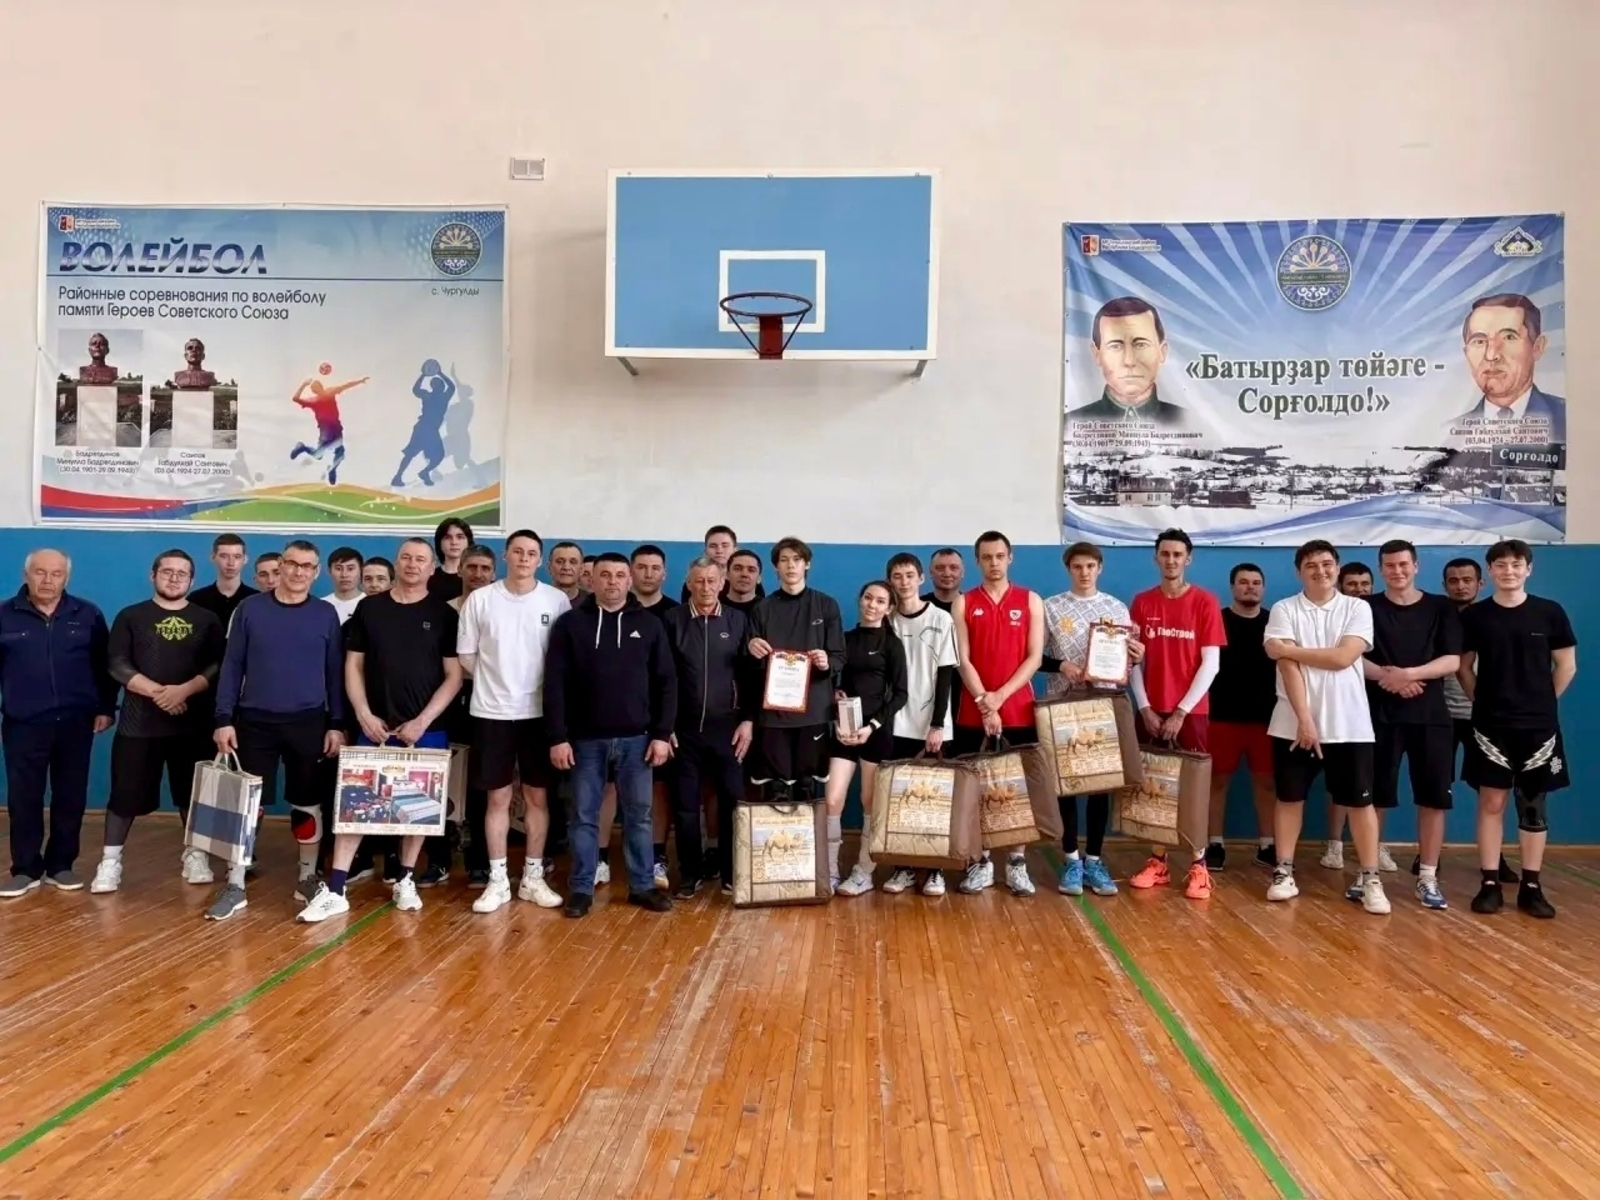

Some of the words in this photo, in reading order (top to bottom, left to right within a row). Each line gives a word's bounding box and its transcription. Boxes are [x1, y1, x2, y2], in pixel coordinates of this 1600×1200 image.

[59, 237, 267, 275] ВОЛЕЙБОЛ
[59, 286, 126, 300] Районные
[129, 290, 228, 304] соревнования
[232, 292, 249, 303] по
[252, 290, 326, 306] волейболу
[441, 286, 480, 297] Чургулды
[58, 305, 105, 316] памяти
[107, 302, 155, 319] Героев
[158, 304, 239, 319] Советского
[241, 305, 289, 320] Союза
[1185, 353, 1330, 385] «Батырҙар
[1339, 352, 1426, 378] төйәге
[1238, 386, 1391, 420] Сорғолдо!»
